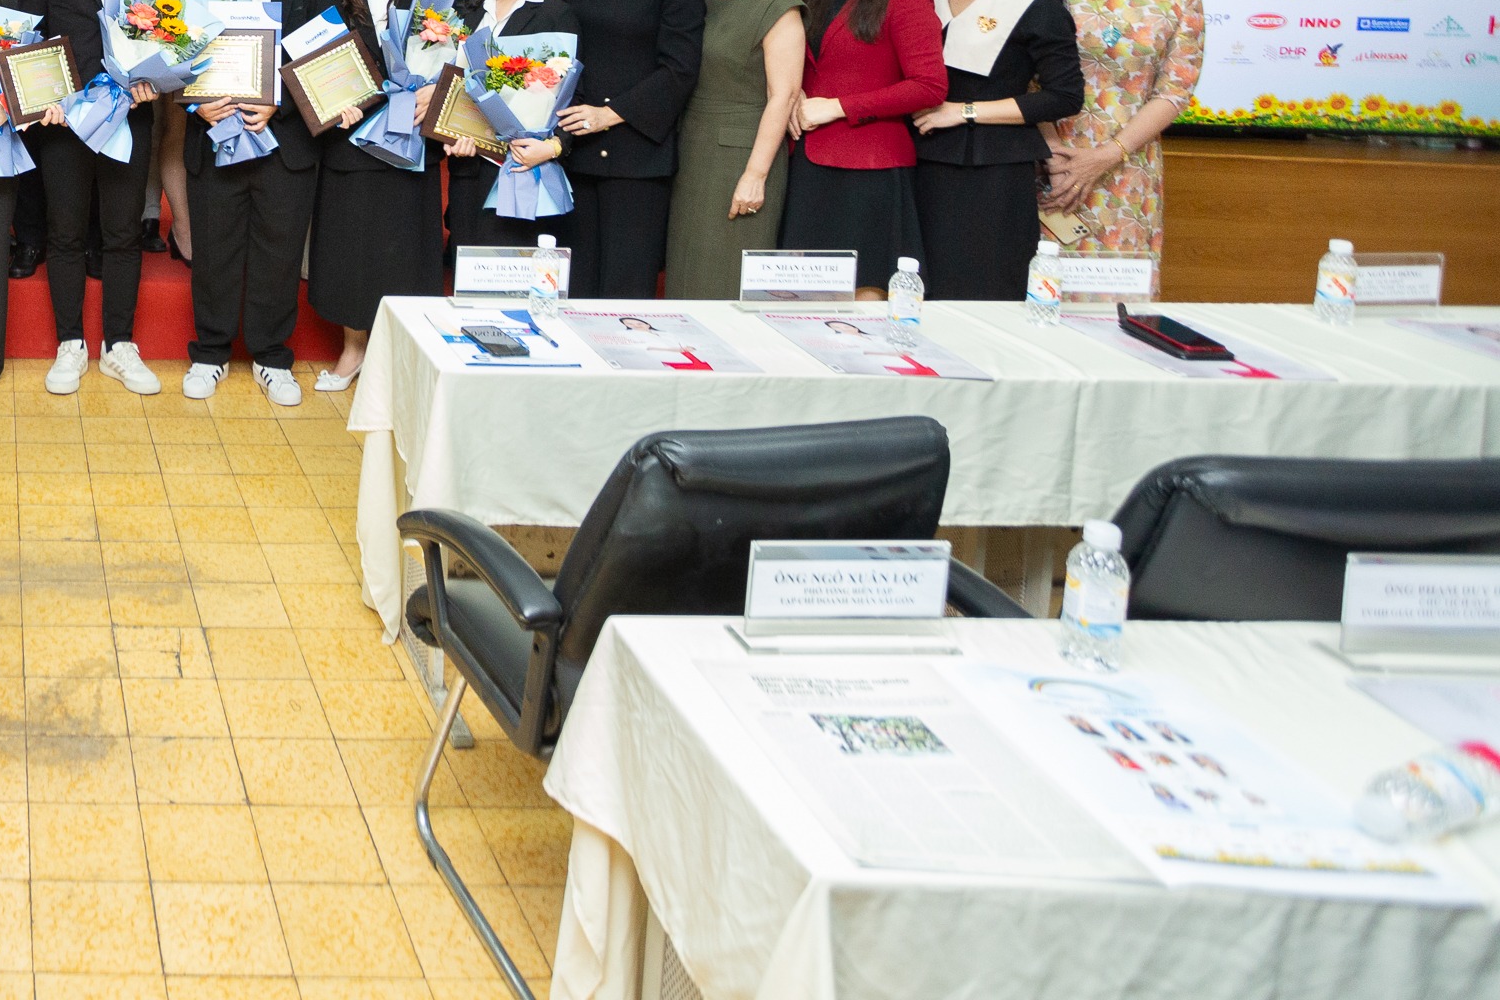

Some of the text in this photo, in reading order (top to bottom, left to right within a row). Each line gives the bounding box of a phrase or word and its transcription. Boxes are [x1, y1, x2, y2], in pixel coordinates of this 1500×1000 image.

[1300, 18, 1341, 28] INNO
[1279, 47, 1307, 56] DHR
[774, 569, 923, 587] ÔNG NGÔ XUÂN LỌC
[1384, 581, 1414, 596] ÔNG
